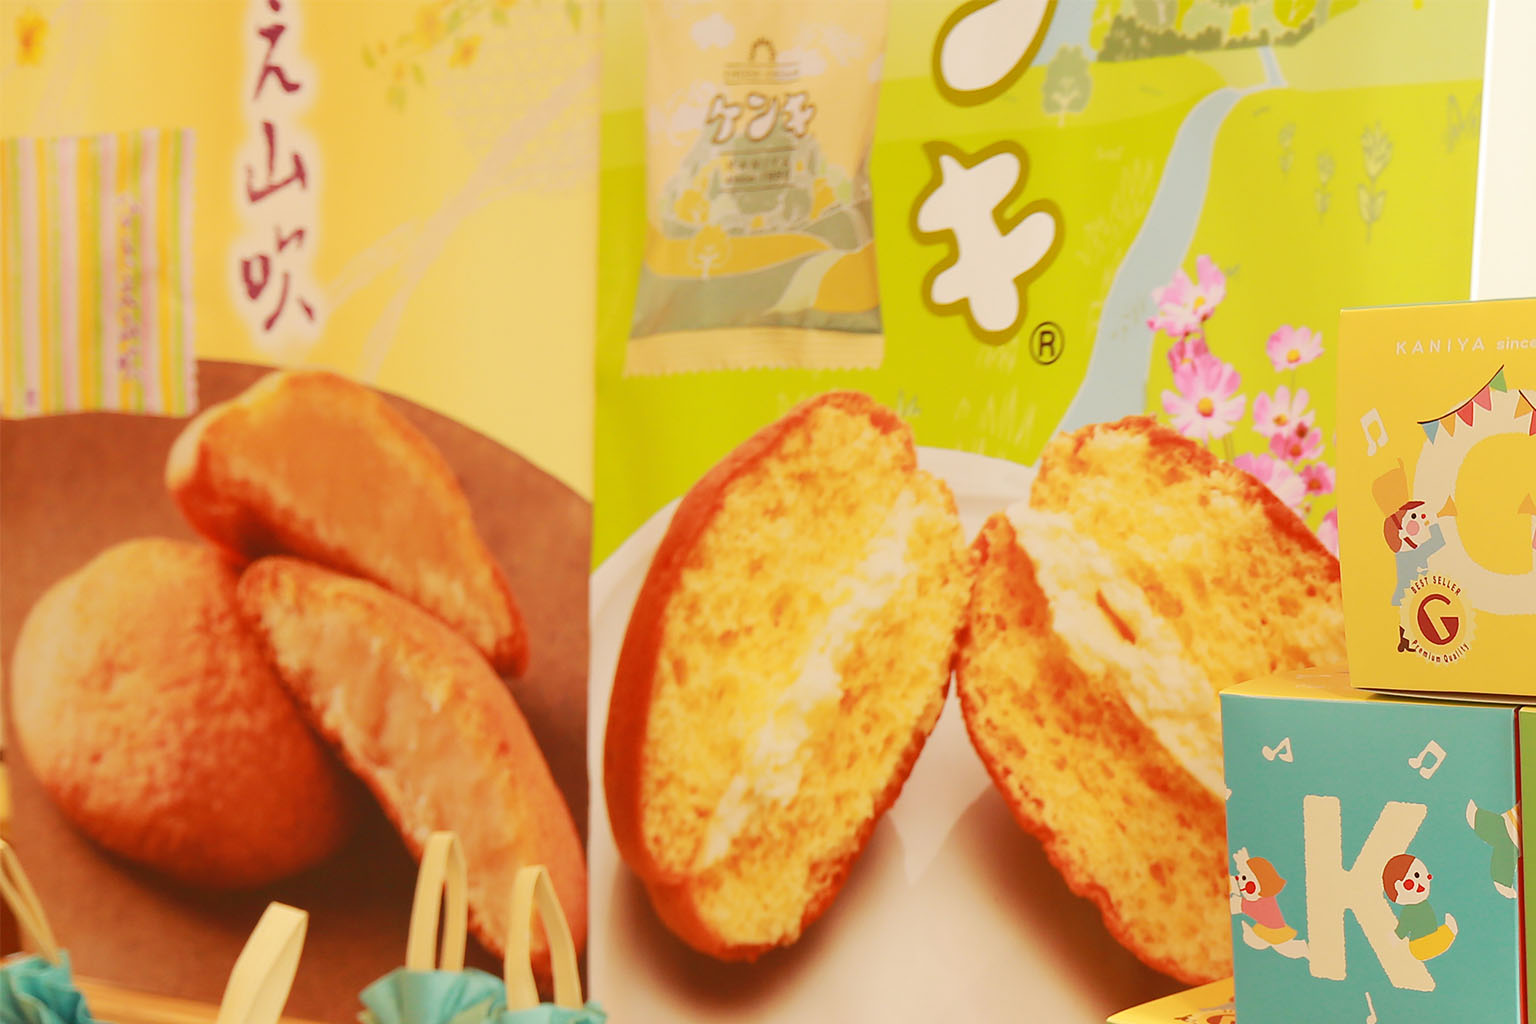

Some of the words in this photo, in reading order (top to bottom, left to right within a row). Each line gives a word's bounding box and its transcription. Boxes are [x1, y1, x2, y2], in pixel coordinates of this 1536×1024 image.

[706, 89, 817, 144] ケンキ
[1395, 336, 1486, 355] KANIYA
[1410, 576, 1429, 594] BEST
[1432, 575, 1462, 596] SELLER
[1417, 593, 1460, 646] G
[1410, 639, 1441, 663] Premium
[1443, 642, 1470, 664] Quality
[1303, 794, 1437, 993] K
